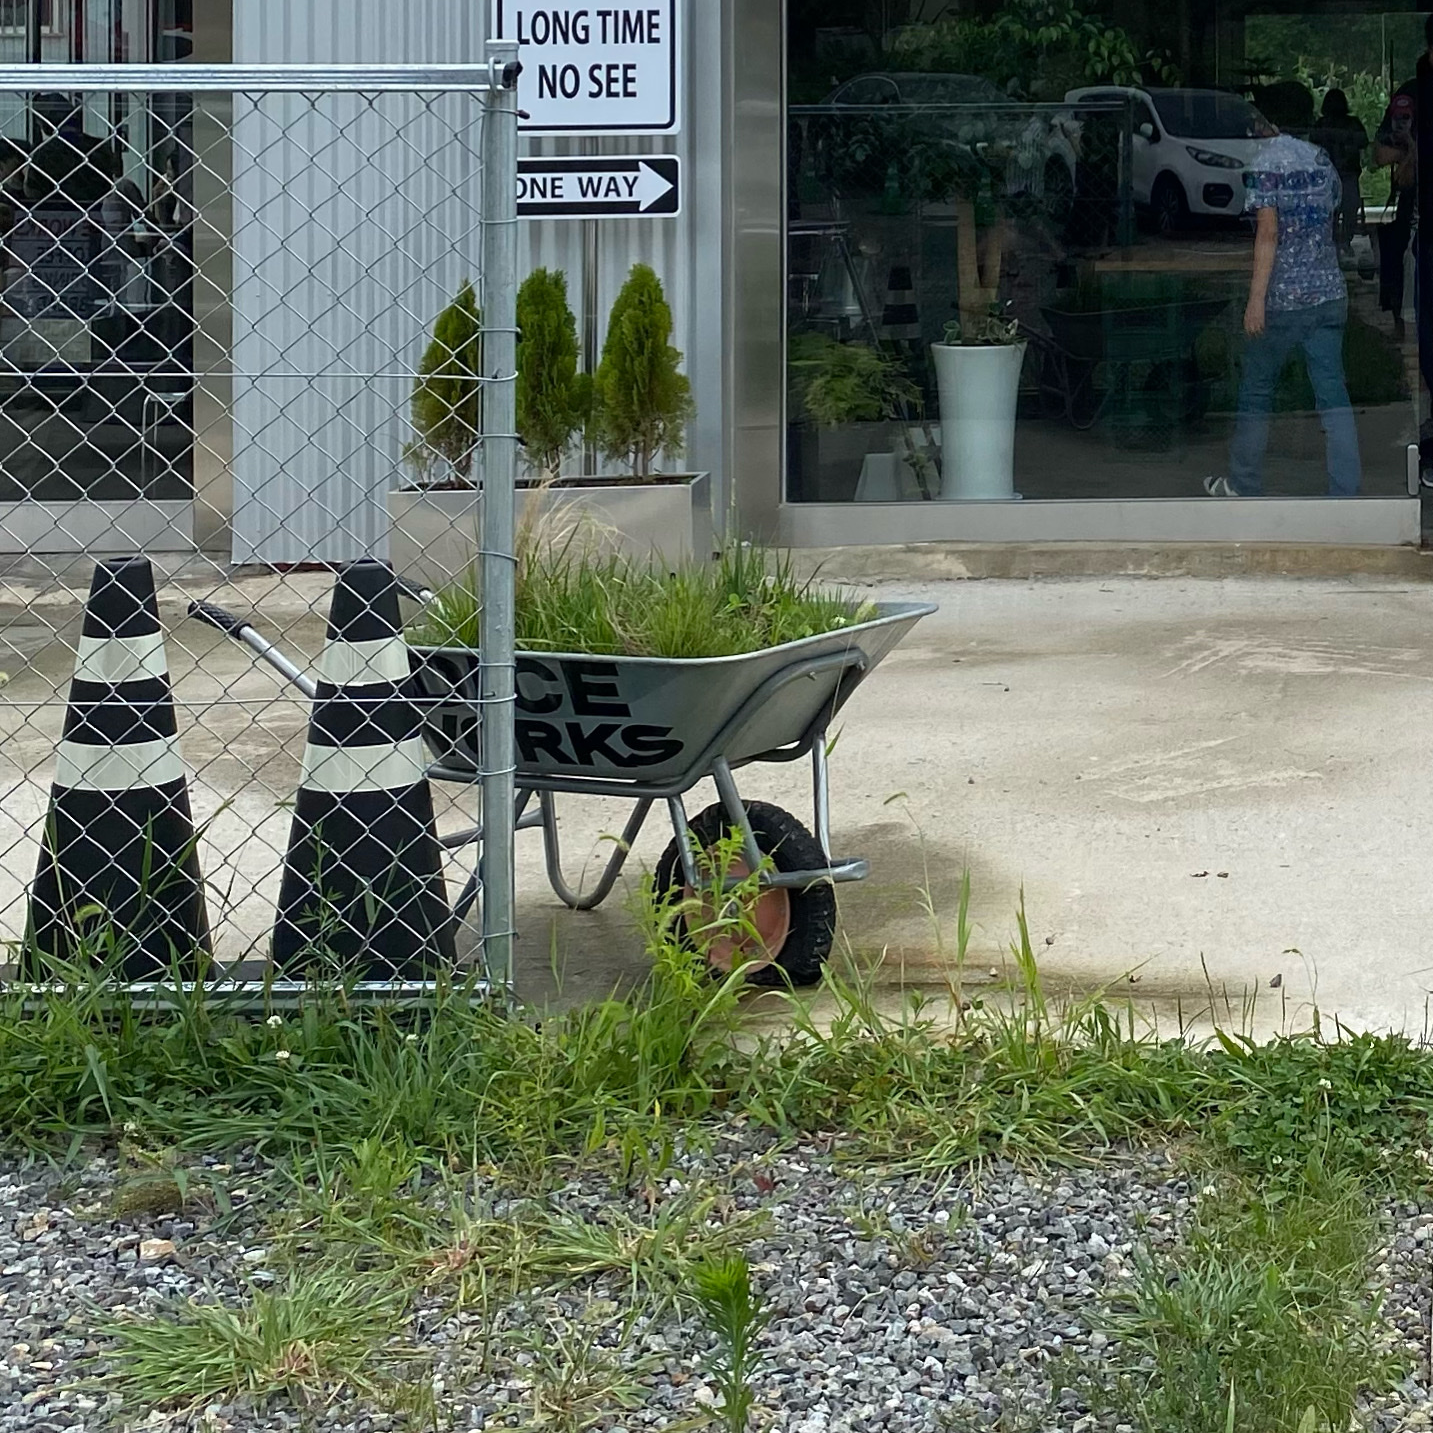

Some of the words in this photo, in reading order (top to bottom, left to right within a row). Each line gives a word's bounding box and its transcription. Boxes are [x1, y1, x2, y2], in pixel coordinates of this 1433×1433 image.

[516, 10, 590, 45] LONG
[597, 9, 660, 44] TIME
[538, 64, 580, 99] NO
[588, 63, 637, 98] SEE
[577, 175, 640, 198] WAY
